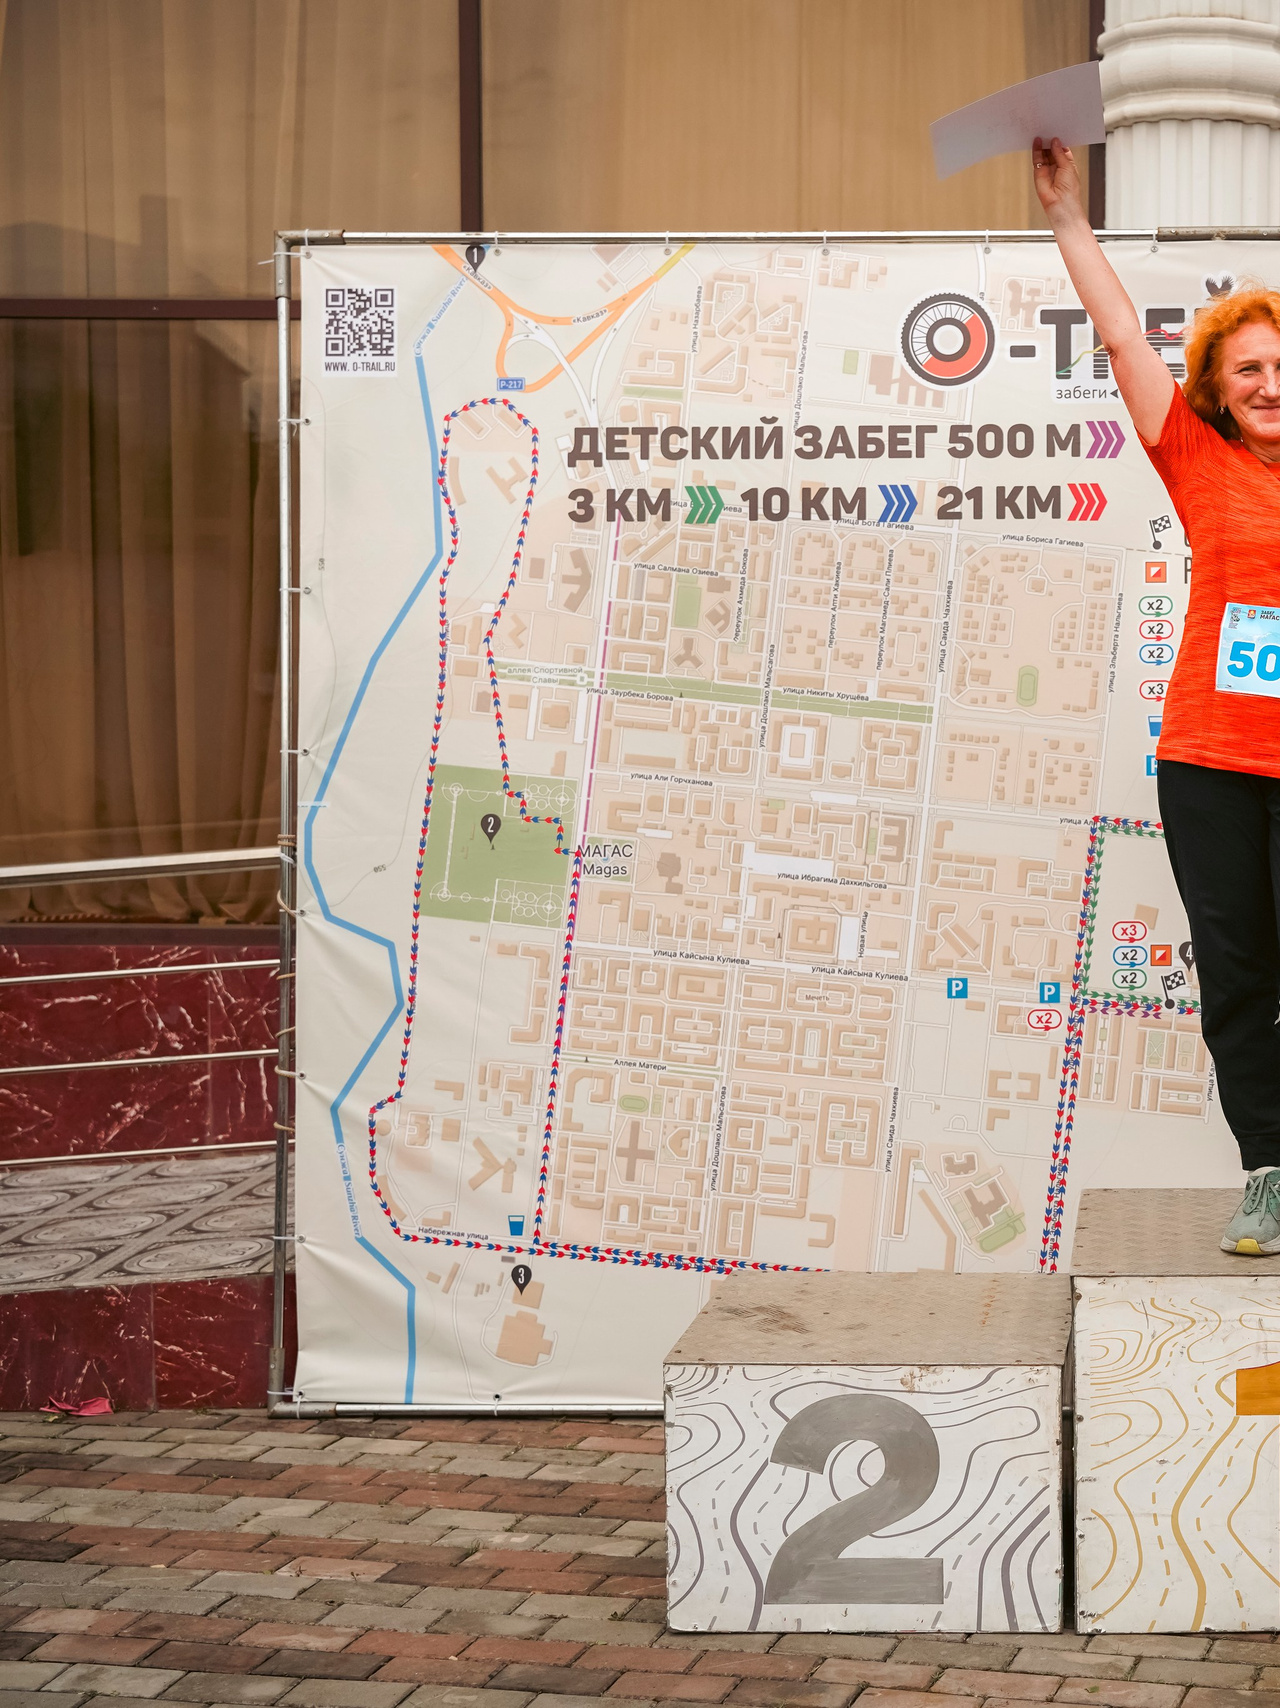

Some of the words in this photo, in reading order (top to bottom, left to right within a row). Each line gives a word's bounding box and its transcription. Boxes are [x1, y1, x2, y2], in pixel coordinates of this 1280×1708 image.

[1055, 387, 1108, 402] забеги
[567, 415, 784, 467] ДЕТСКИЙ
[794, 424, 937, 459] ЗАБЕГ
[947, 423, 1034, 459] 500
[1046, 423, 1081, 459] М
[567, 487, 595, 523] 3
[607, 487, 672, 522] КМ
[741, 486, 790, 522] 10
[802, 486, 867, 521] КМ
[937, 485, 983, 520] 21
[998, 485, 1061, 520] КМ
[1002, 533, 1024, 543] улица
[1026, 535, 1053, 545] Бориса
[1055, 538, 1084, 548] Гагиева
[633, 562, 656, 572] улица
[658, 564, 690, 575] Салмана
[692, 567, 719, 577] Озиева
[886, 549, 894, 576] Плиева
[880, 578, 891, 634] Магомед-Сали
[944, 580, 954, 620] Чахкиева
[1147, 599, 1163, 610] x2
[1113, 592, 1124, 633] Нальгиева
[940, 621, 949, 648] Саида
[1148, 623, 1163, 634] x2
[876, 636, 885, 671] переулок
[938, 649, 946, 673] улица
[1110, 634, 1120, 670] Эльберта
[1148, 647, 1164, 658] x2
[764, 644, 775, 688] Мальсагова
[1107, 671, 1116, 693] улица
[586, 687, 608, 696] улица
[609, 688, 645, 699] Заурбека
[646, 692, 674, 701] Борова
[782, 686, 805, 696] улица
[806, 688, 834, 698] Никиты
[836, 690, 869, 702] Хрущёва
[760, 691, 770, 724] Дошлако
[759, 725, 767, 748] улица
[577, 844, 633, 858] МАГАС
[582, 863, 628, 878] Magas
[777, 871, 799, 881] улица
[801, 873, 837, 885] Ибрагима
[839, 876, 888, 891] Дахкильгова
[653, 948, 677, 959] улица
[679, 950, 714, 963] Кайсына
[716, 954, 750, 966] Кулиева
[1122, 949, 1138, 961] x2
[811, 965, 835, 976] улица
[837, 967, 873, 980] Кайсына
[874, 970, 909, 982] Кулиева
[1121, 972, 1137, 984] x2
[805, 993, 830, 1003] Мечеть
[952, 980, 964, 997] P
[1044, 984, 1056, 1001] P
[1035, 1012, 1053, 1025] x2
[613, 1058, 636, 1068] Аллея
[638, 1061, 667, 1072] Матери
[716, 1086, 727, 1131] Мальсагова
[712, 1132, 721, 1168] Дошлако
[710, 1169, 718, 1192] улица
[418, 1226, 465, 1240] Набережная
[466, 1231, 489, 1242] улица
[763, 1393, 945, 1606] 2
